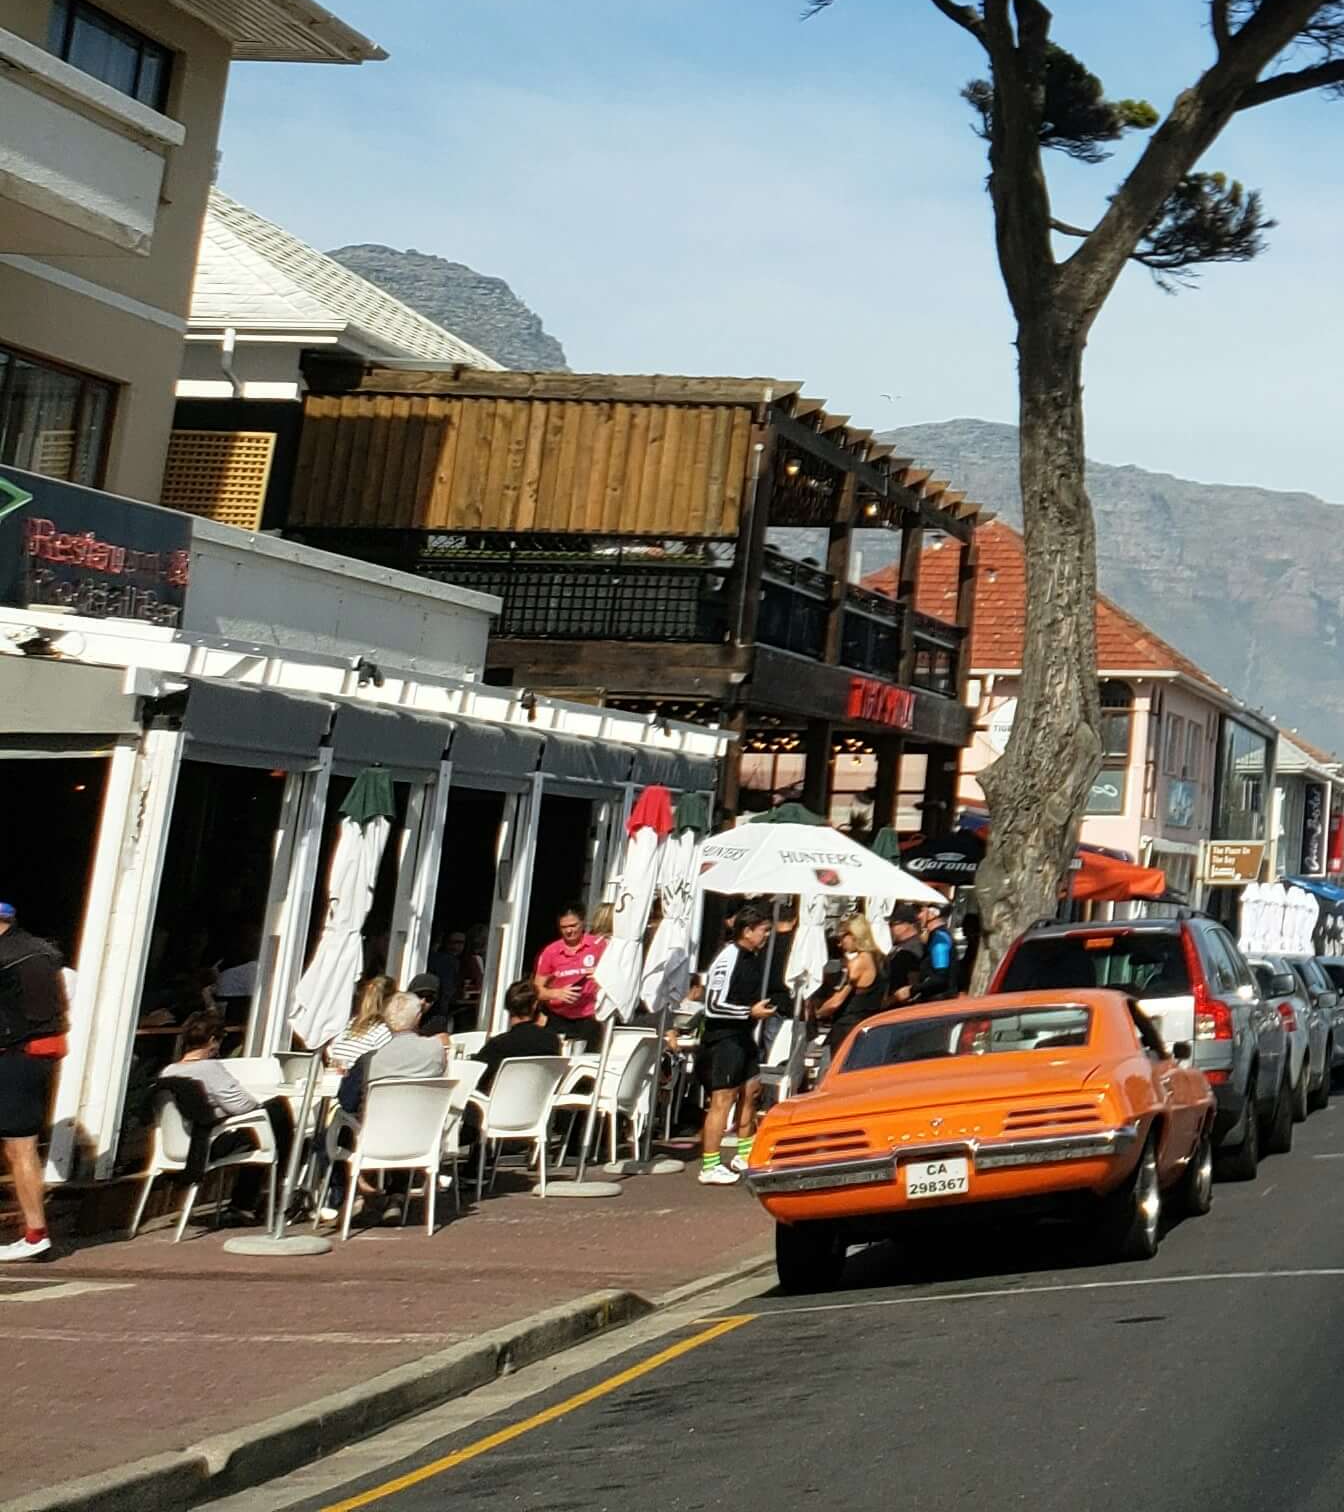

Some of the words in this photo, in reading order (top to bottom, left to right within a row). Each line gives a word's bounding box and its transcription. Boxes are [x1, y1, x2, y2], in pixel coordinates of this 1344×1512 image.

[907, 857, 977, 872] Corona
[926, 1163, 948, 1176] CA
[909, 1177, 965, 1195] 298367
